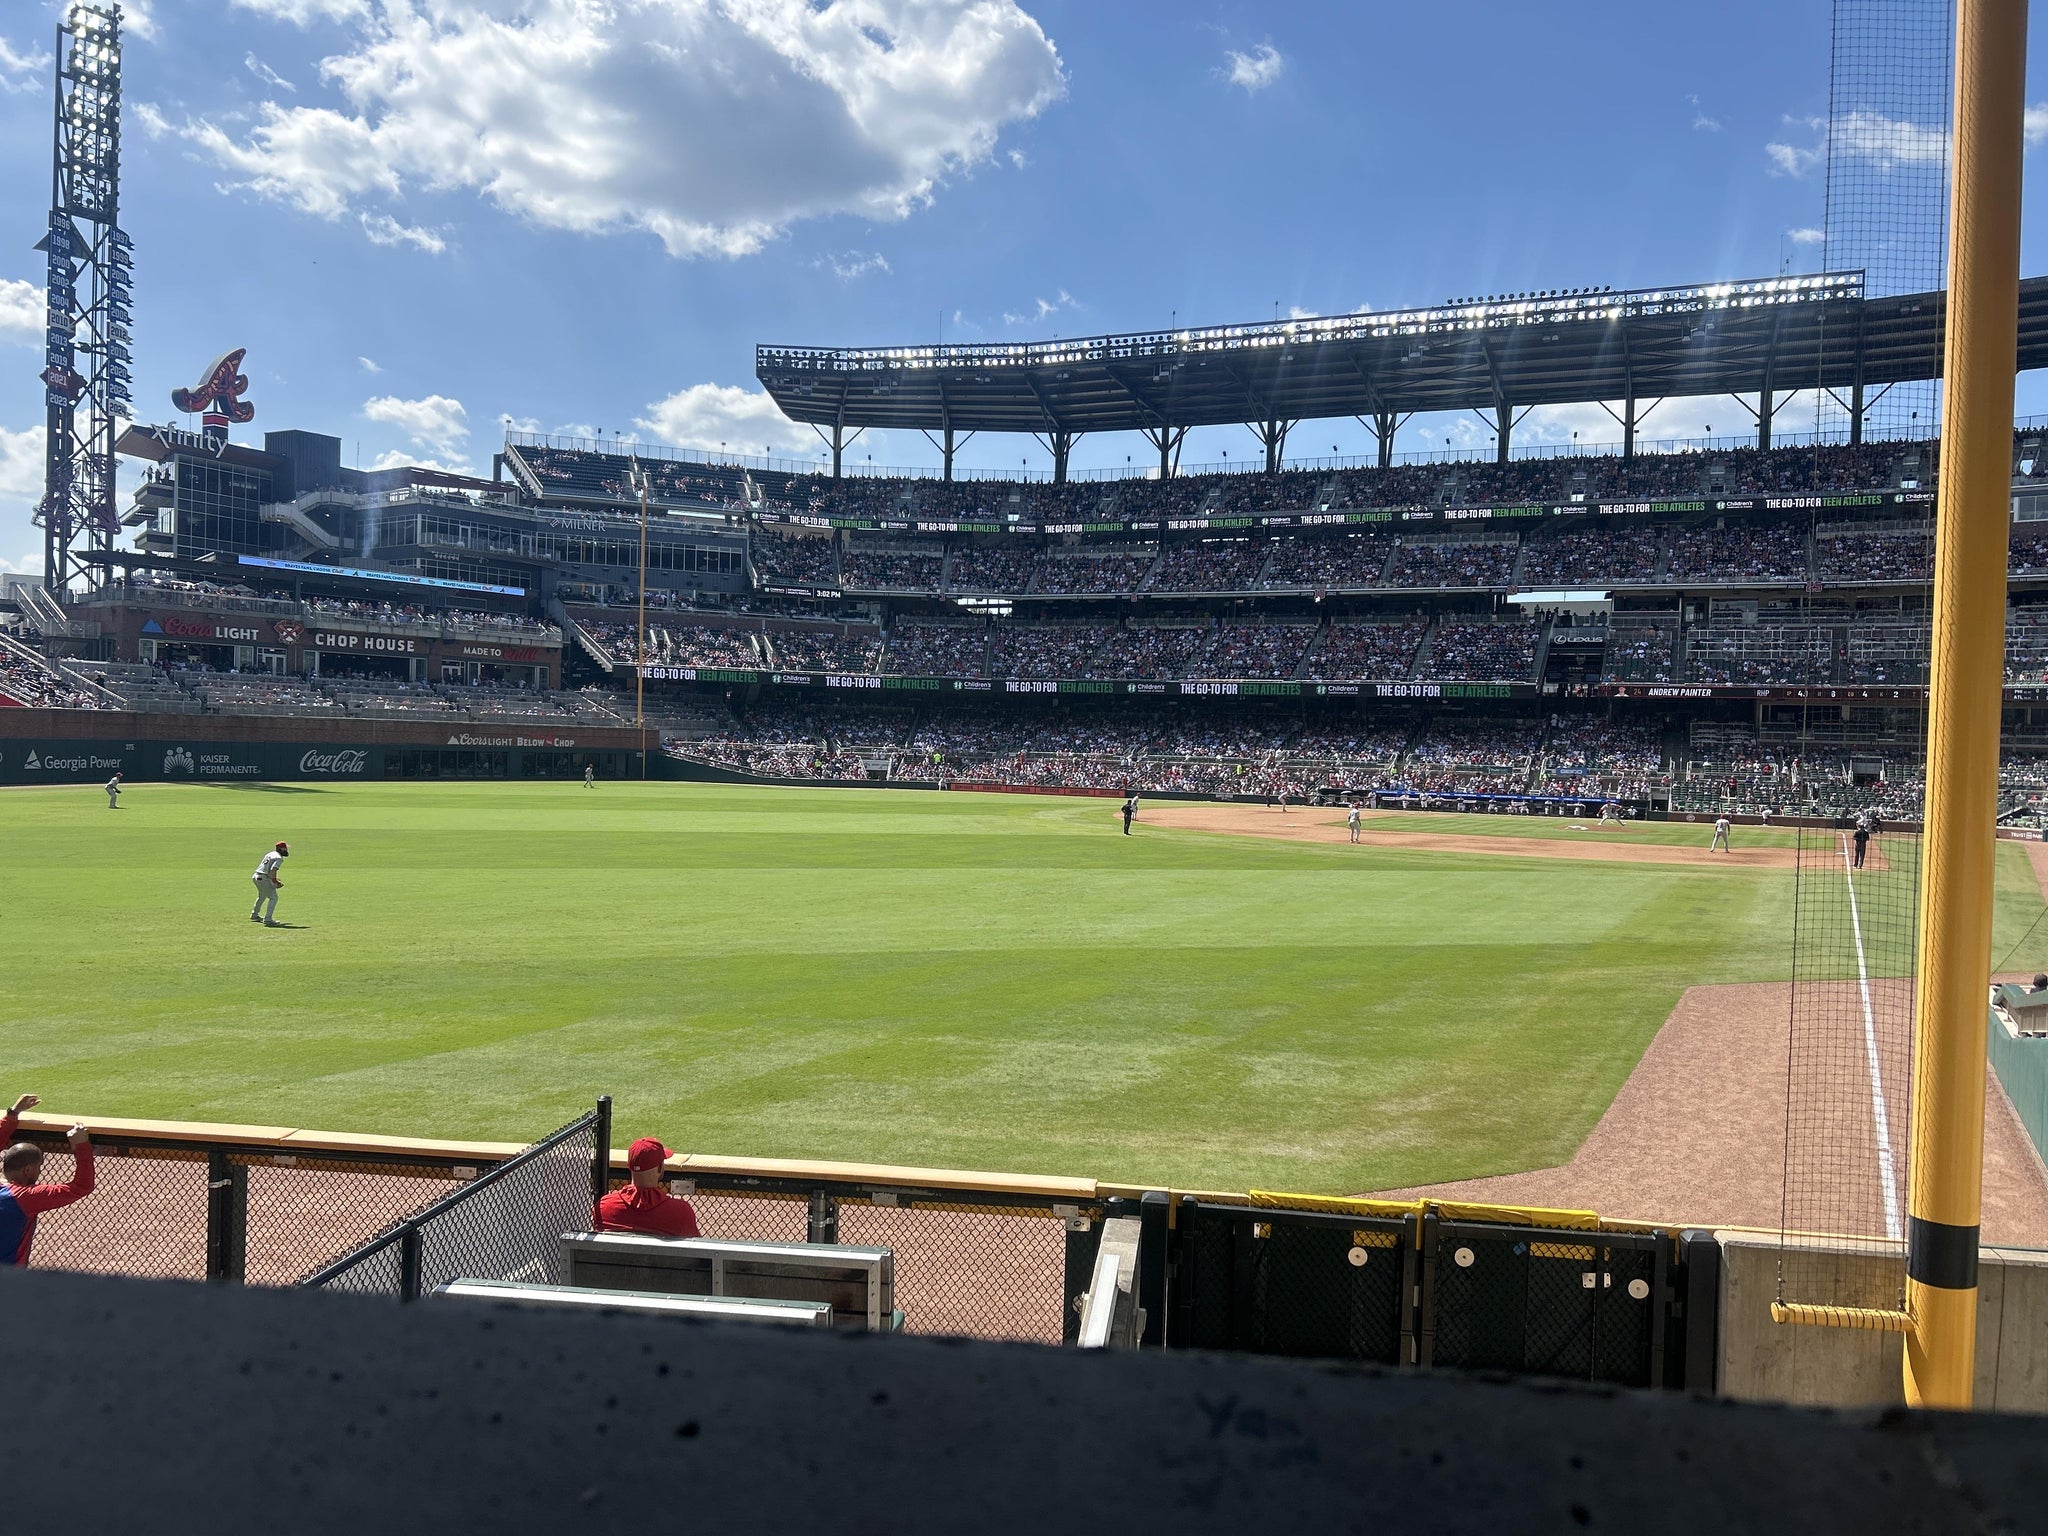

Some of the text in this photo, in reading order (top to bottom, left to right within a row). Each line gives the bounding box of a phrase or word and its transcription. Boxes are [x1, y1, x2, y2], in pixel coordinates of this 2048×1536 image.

[53, 215, 70, 230] 1996
[52, 235, 70, 249] 1998
[112, 230, 128, 243] 1997
[52, 255, 70, 269] 2000
[112, 250, 128, 264] 1999
[52, 274, 69, 288] 2002
[112, 269, 128, 282] 2001
[52, 294, 69, 308] 2004
[112, 288, 128, 302] 2003
[51, 313, 68, 327] 2010
[111, 308, 128, 321] 2005
[51, 333, 68, 346] 2013
[111, 326, 127, 340] 2012
[111, 346, 127, 359] 2018
[50, 353, 68, 366] 2019
[110, 365, 127, 377] 2020
[50, 372, 67, 386] 2021
[110, 384, 127, 396] 2022
[50, 393, 67, 406] 2023
[109, 403, 126, 415] 2024
[150, 421, 229, 458] xfinity
[1599, 502, 1705, 514] THE GO-TO FOR TEEN ATHLETES
[1766, 496, 1882, 508] THE GO-TO FOR TEEN ATHLETES
[1301, 513, 1392, 524] THE GO-TO FOR TEEN ATHLETES
[1445, 508, 1543, 519] THE GO-TO FOR TEEN ATHLETES
[561, 519, 606, 532] MILNER
[801, 516, 818, 525] GO-TO
[830, 519, 844, 527] TEEN
[844, 519, 872, 528] ATHLETES
[917, 523, 1000, 533] THE GO-TO FOR TEEN ATHLETES
[1045, 525, 1055, 533] THE
[1056, 525, 1071, 533] GO-TO
[1097, 523, 1124, 531] ATHLETES
[1168, 518, 1253, 529] THE GO-TO FOR TEEN ATHLETES
[164, 617, 259, 641] Coors LIGHT
[315, 633, 415, 652] CHOP HOUSE
[463, 647, 488, 655] MADE
[490, 648, 501, 657] TO
[636, 667, 758, 683] THE GO-TO FOR TEEN ATHLETES
[826, 676, 939, 690] THE GO-TO FOR TEEN ATHLETES
[1006, 682, 1113, 694] THE GO-TO FOR TEEN ATHLETES
[1180, 684, 1300, 695] THE GO-TO FOR TEEN ATHLETES
[1376, 685, 1510, 698] THE GO-TO FOR TEEN ATHLETES
[460, 733, 488, 745] Coors
[517, 737, 544, 746] BELOW
[554, 738, 575, 747] CHOP
[44, 756, 122, 771] Georgia Power
[201, 755, 229, 763] KAISER
[300, 749, 368, 773] Coca-Cola
[201, 766, 258, 774] PERMANENTE
